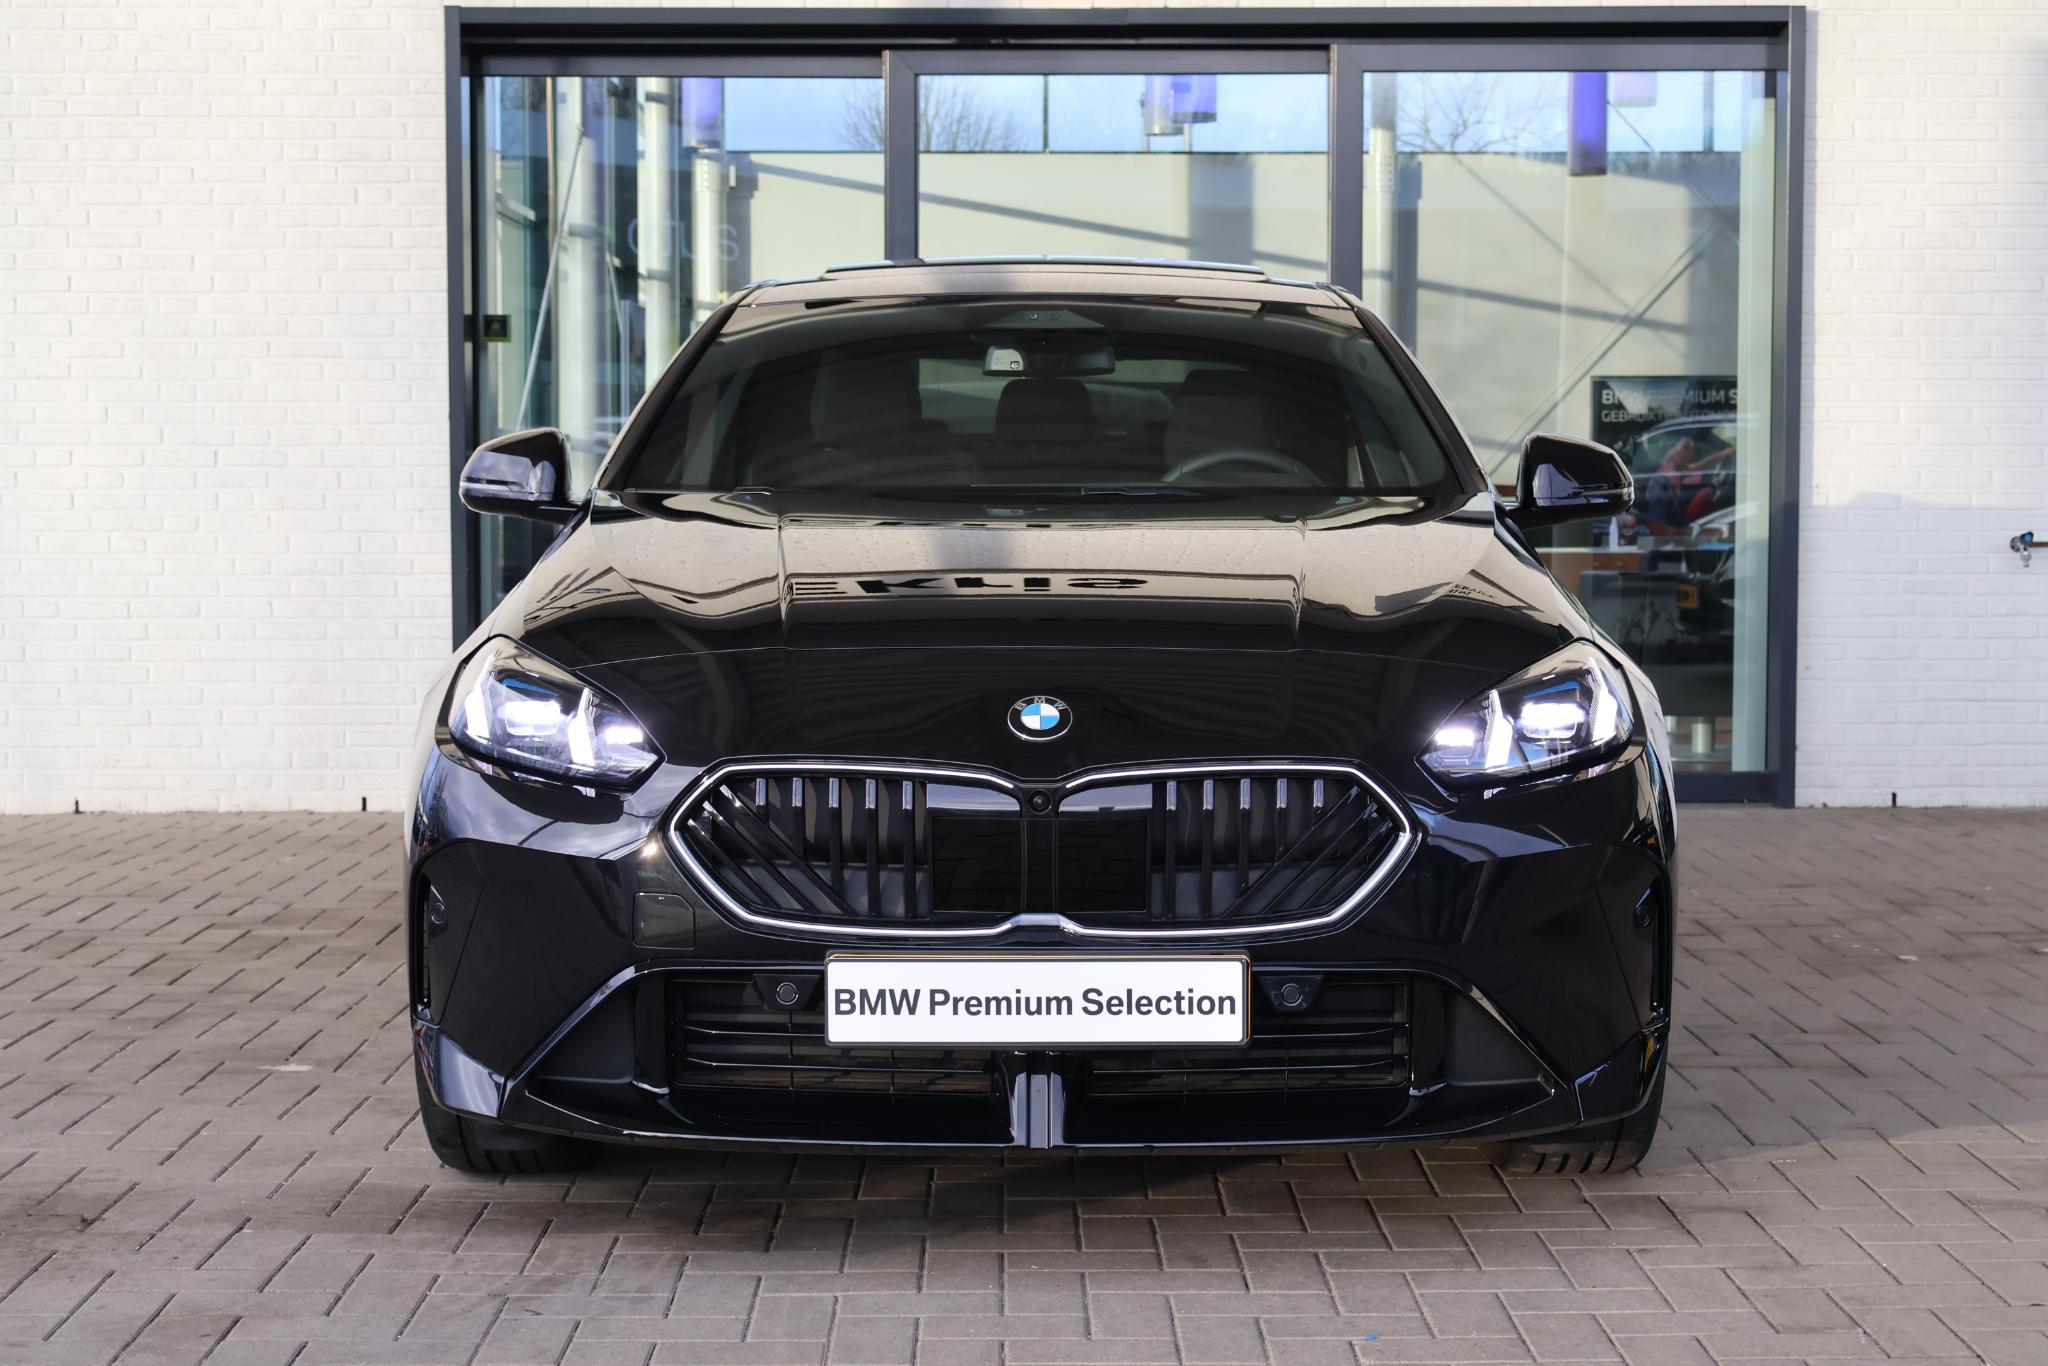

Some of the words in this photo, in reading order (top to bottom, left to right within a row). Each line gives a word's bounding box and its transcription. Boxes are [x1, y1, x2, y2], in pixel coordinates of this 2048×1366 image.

[1014, 696, 1067, 711] BMW
[834, 987, 921, 1016] BMW
[929, 987, 1073, 1016] Premium
[1082, 987, 1236, 1016] Selection
